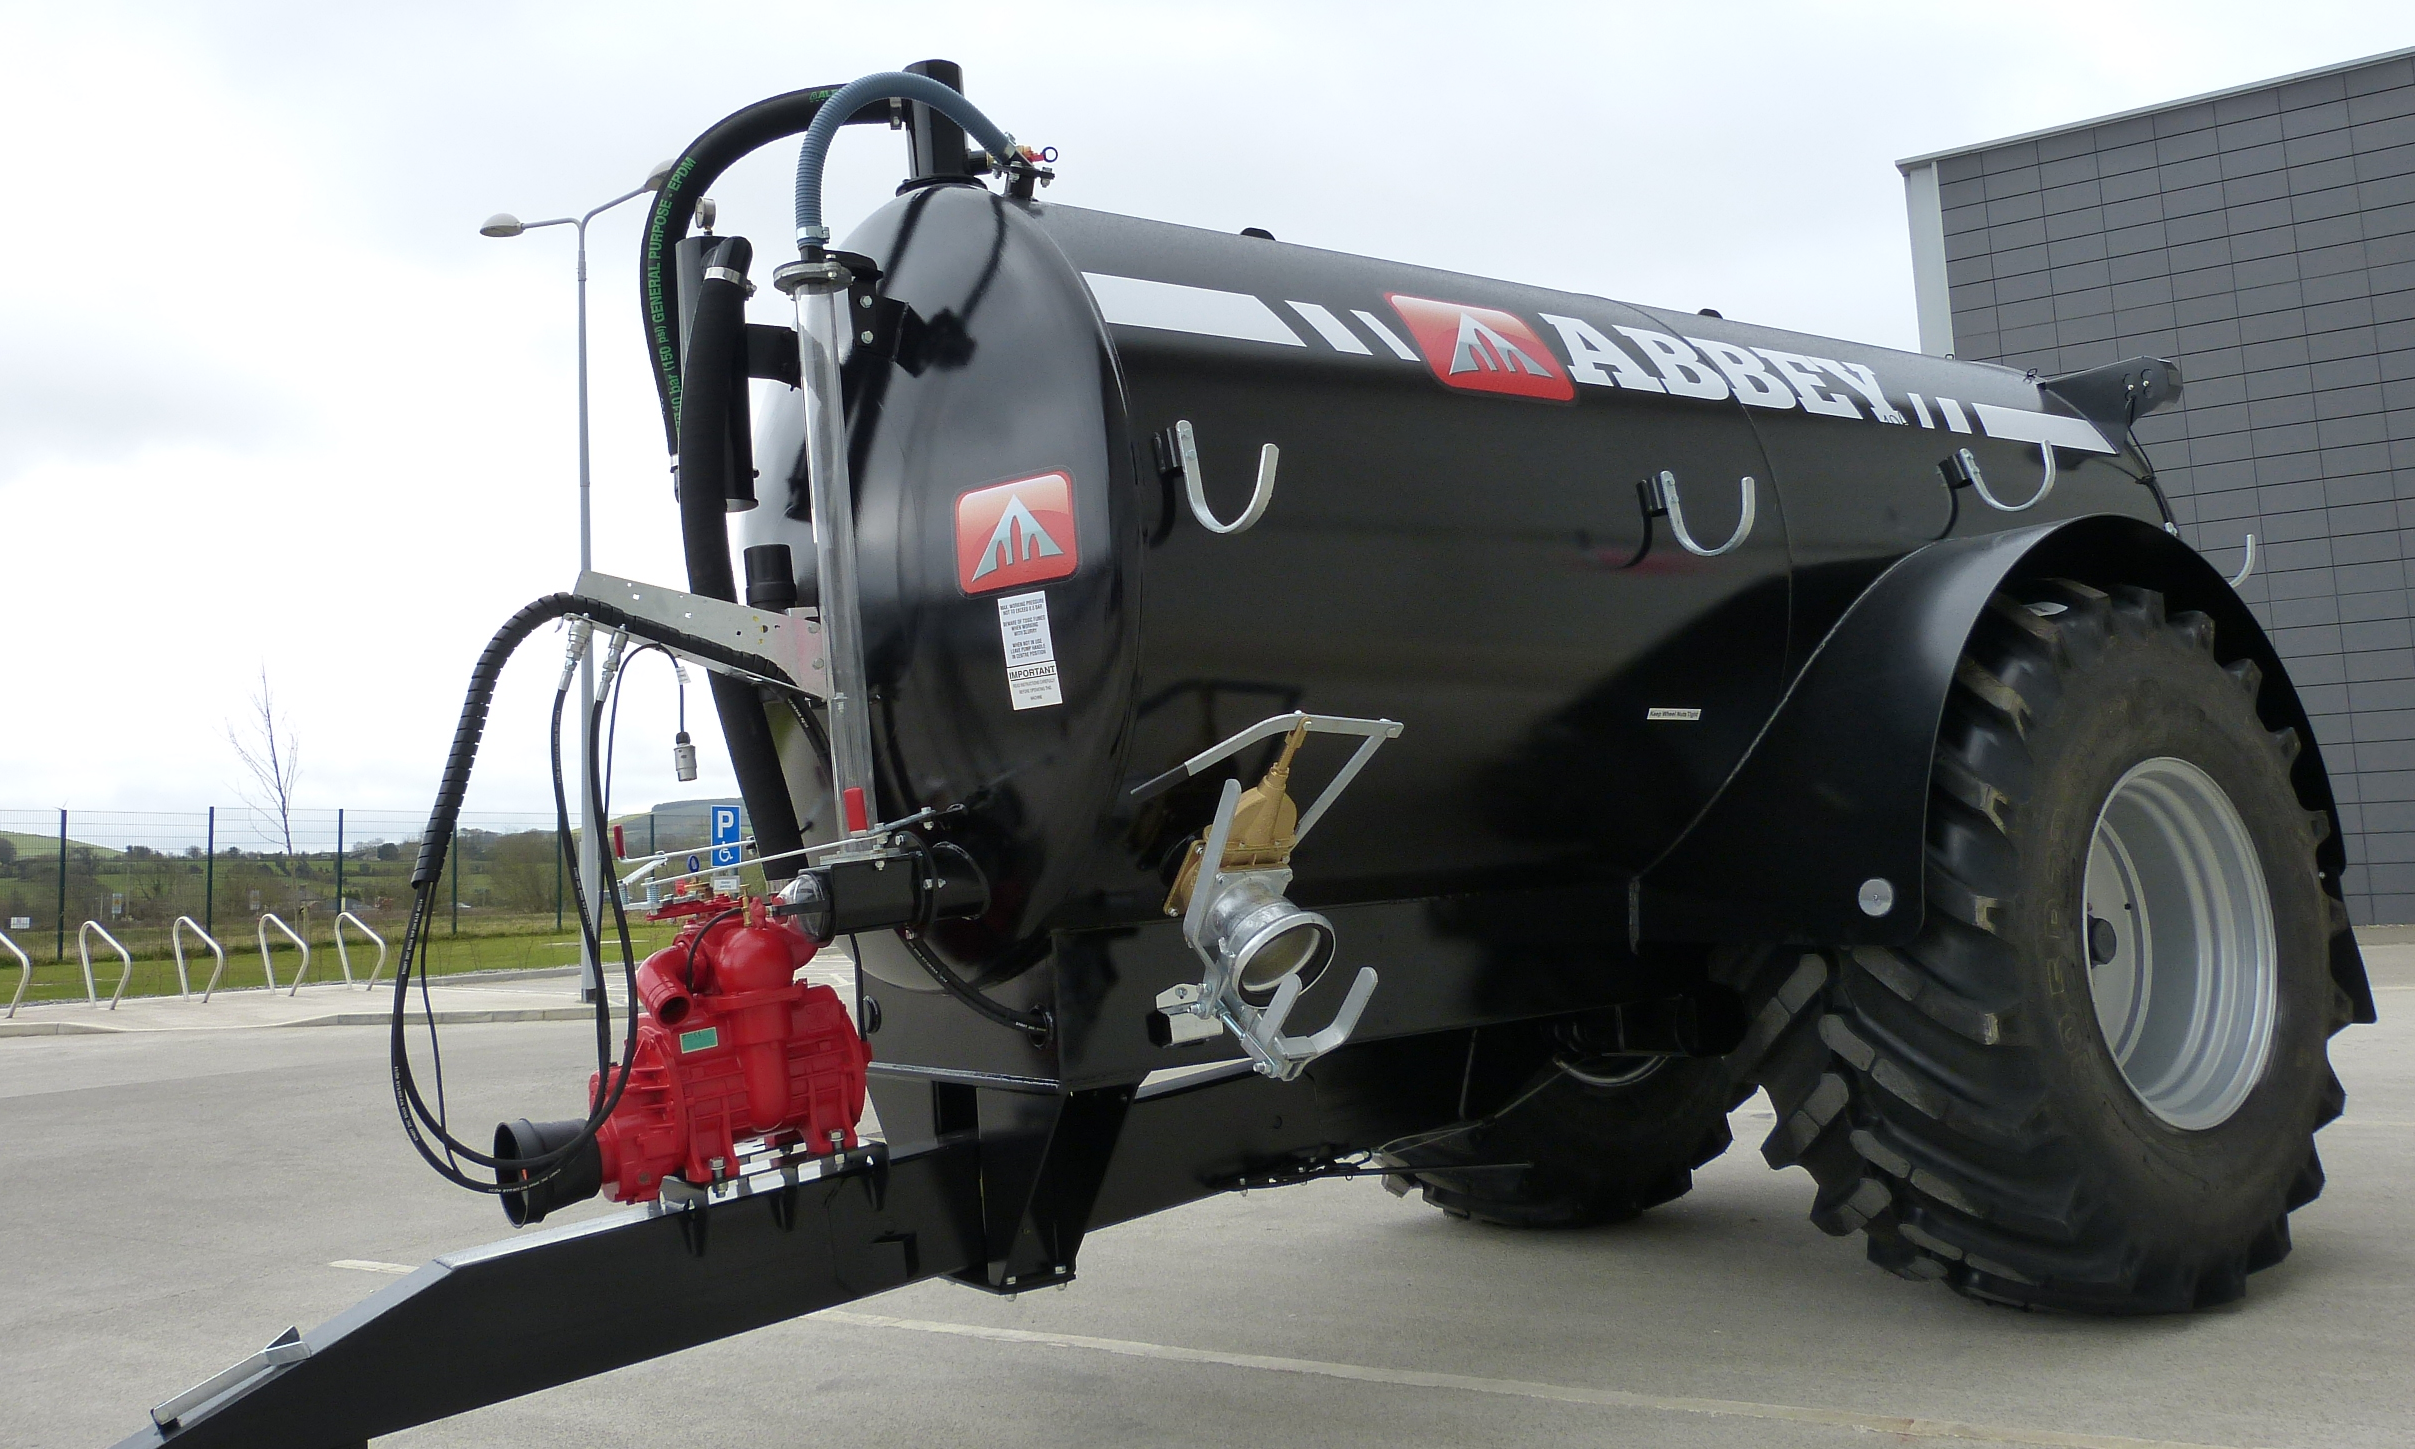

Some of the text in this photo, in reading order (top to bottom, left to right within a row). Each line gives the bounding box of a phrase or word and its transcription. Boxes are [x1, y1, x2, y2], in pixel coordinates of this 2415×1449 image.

[667, 156, 696, 191] EPDM
[648, 199, 672, 259] PURPOSE
[648, 262, 665, 323] GENERAL
[654, 326, 669, 343] psi)
[659, 346, 675, 371] (150
[1539, 313, 1909, 426] ABBEY
[668, 374, 681, 395] bar
[1009, 665, 1055, 679] IMPORTANT
[717, 810, 734, 838] P
